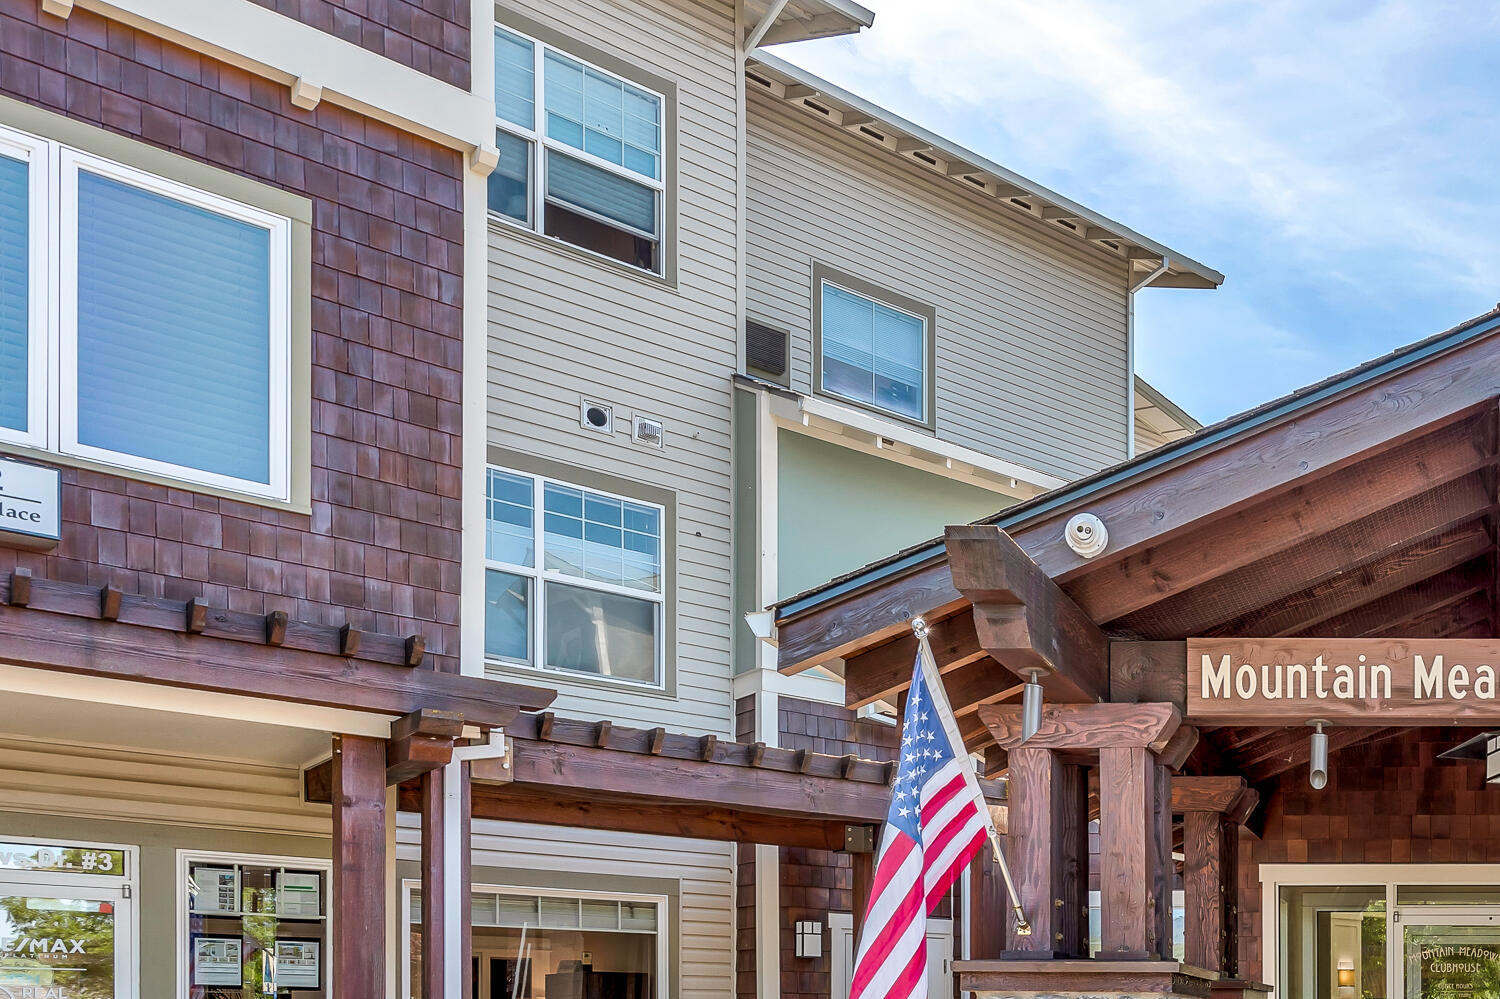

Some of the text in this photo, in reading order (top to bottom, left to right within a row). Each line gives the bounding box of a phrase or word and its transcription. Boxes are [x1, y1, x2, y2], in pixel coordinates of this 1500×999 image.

[1201, 654, 1392, 700] Mountain
[37, 848, 73, 869] Dr.
[81, 851, 113, 871] #3
[1409, 946, 1454, 964] MOUNTAIN
[1430, 963, 1481, 974] CLUBHOUSE
